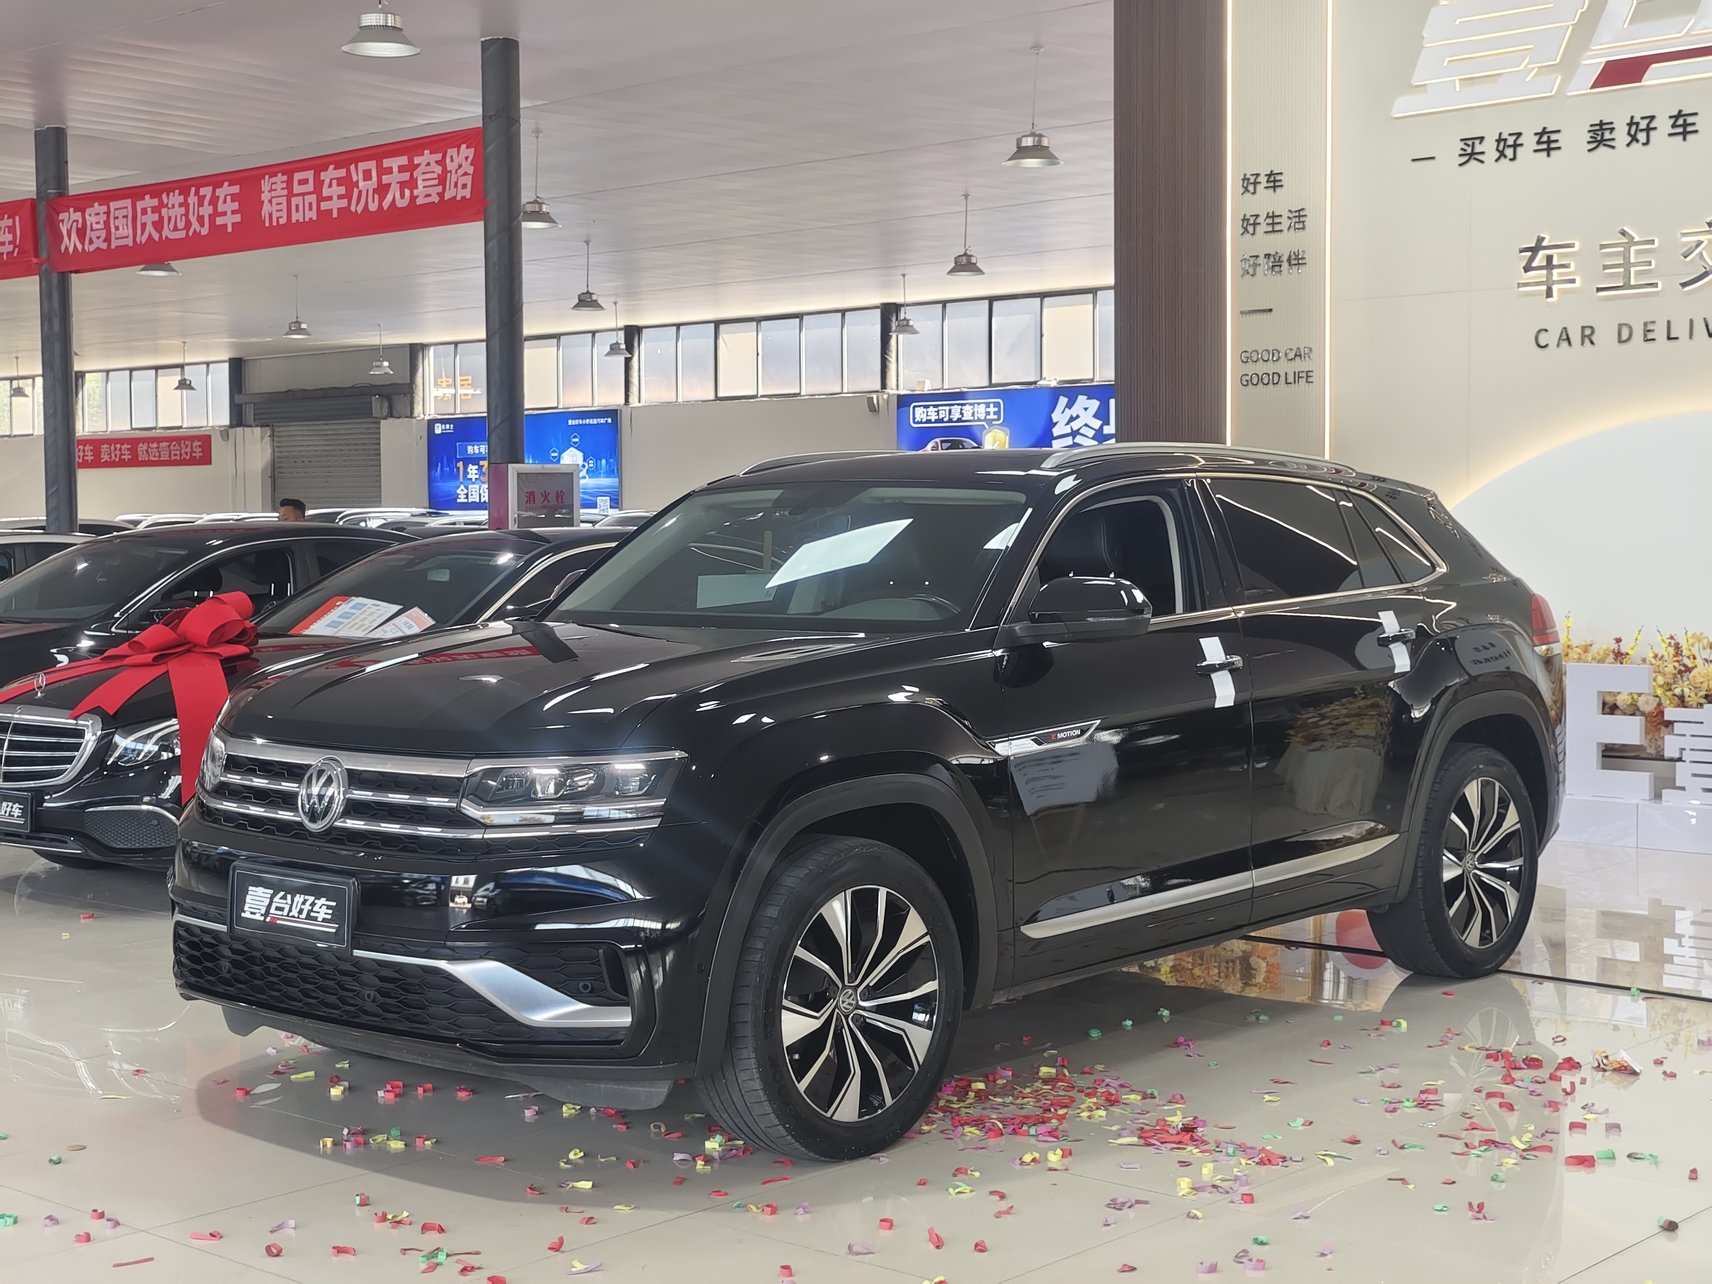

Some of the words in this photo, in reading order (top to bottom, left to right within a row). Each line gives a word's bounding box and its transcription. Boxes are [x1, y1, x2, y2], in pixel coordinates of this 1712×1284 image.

[1458, 127, 1562, 167] 买好车
[1587, 109, 1699, 152] 卖好车
[1240, 170, 1284, 195] 好车
[58, 182, 241, 255] 欢度国庆选好车
[261, 144, 475, 227] 精品车况无套路
[1240, 208, 1308, 236] 好生活
[1240, 249, 1307, 277] 好陪伴
[1534, 325, 1597, 349] CAR
[1240, 349, 1281, 363] GOOD
[1284, 346, 1313, 361] CAR
[1240, 372, 1281, 387] GOOD
[1284, 370, 1314, 385] LIFE
[914, 405, 999, 423] 购车可享查博士
[1051, 395, 1115, 448] 终
[100, 443, 132, 462] 卖好车
[138, 440, 203, 461] 就选壹台好车
[467, 445, 488, 455] 购车可
[525, 489, 566, 505] 消火栓
[241, 886, 337, 922] 壹台好车
